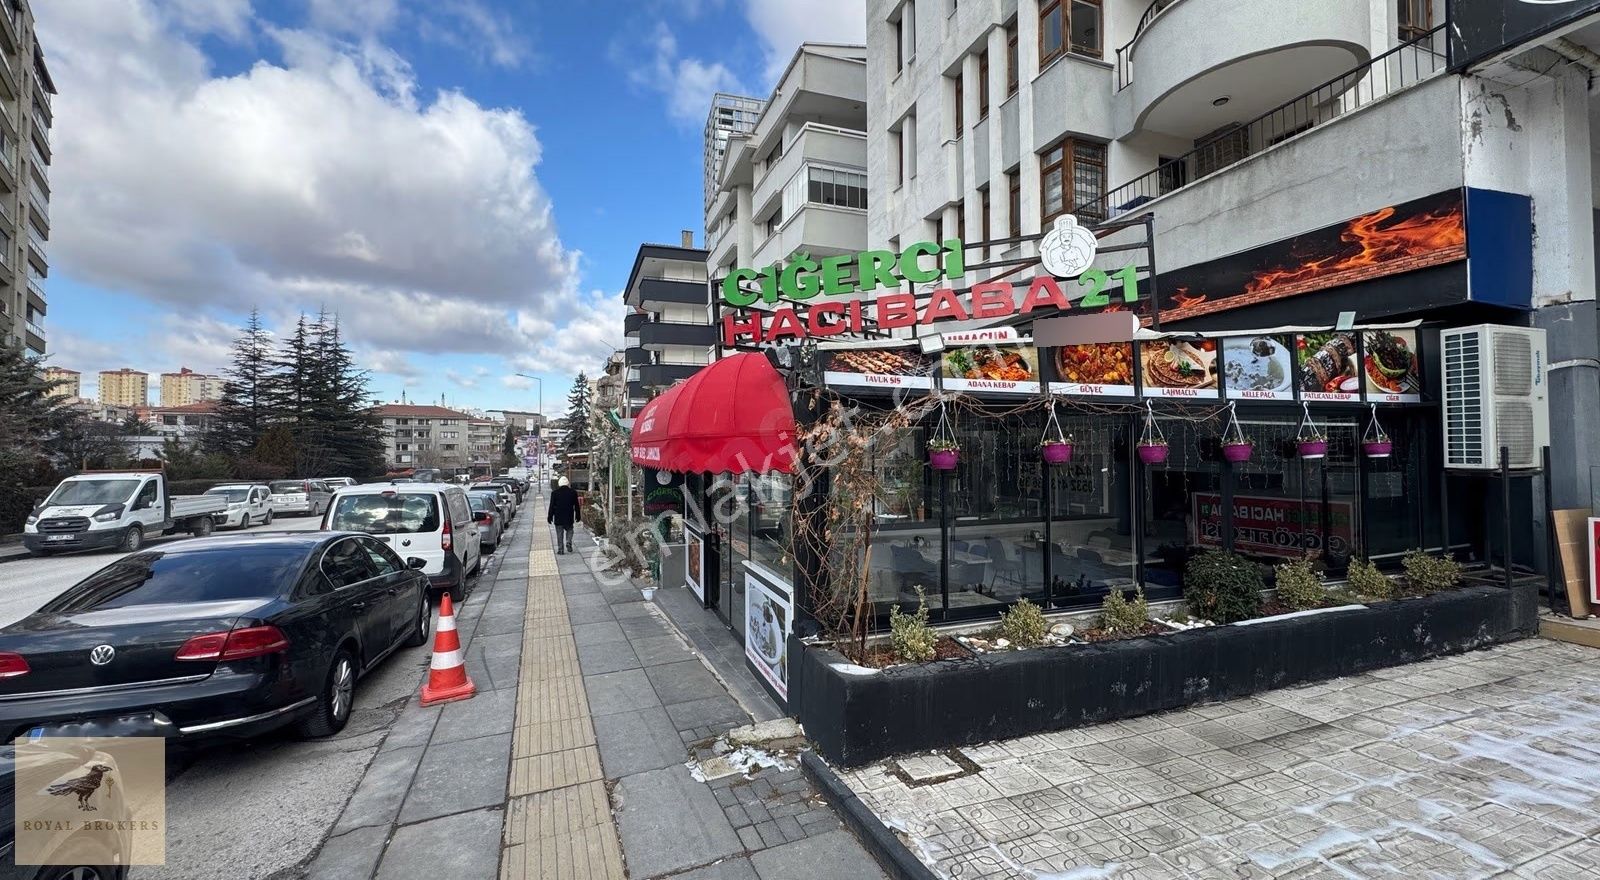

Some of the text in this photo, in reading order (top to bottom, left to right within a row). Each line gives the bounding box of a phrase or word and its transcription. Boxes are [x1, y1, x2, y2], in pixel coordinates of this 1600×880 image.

[1078, 265, 1138, 307] 21
[865, 376, 888, 384] TAVUK
[1162, 388, 1197, 396] LAHMACUN
